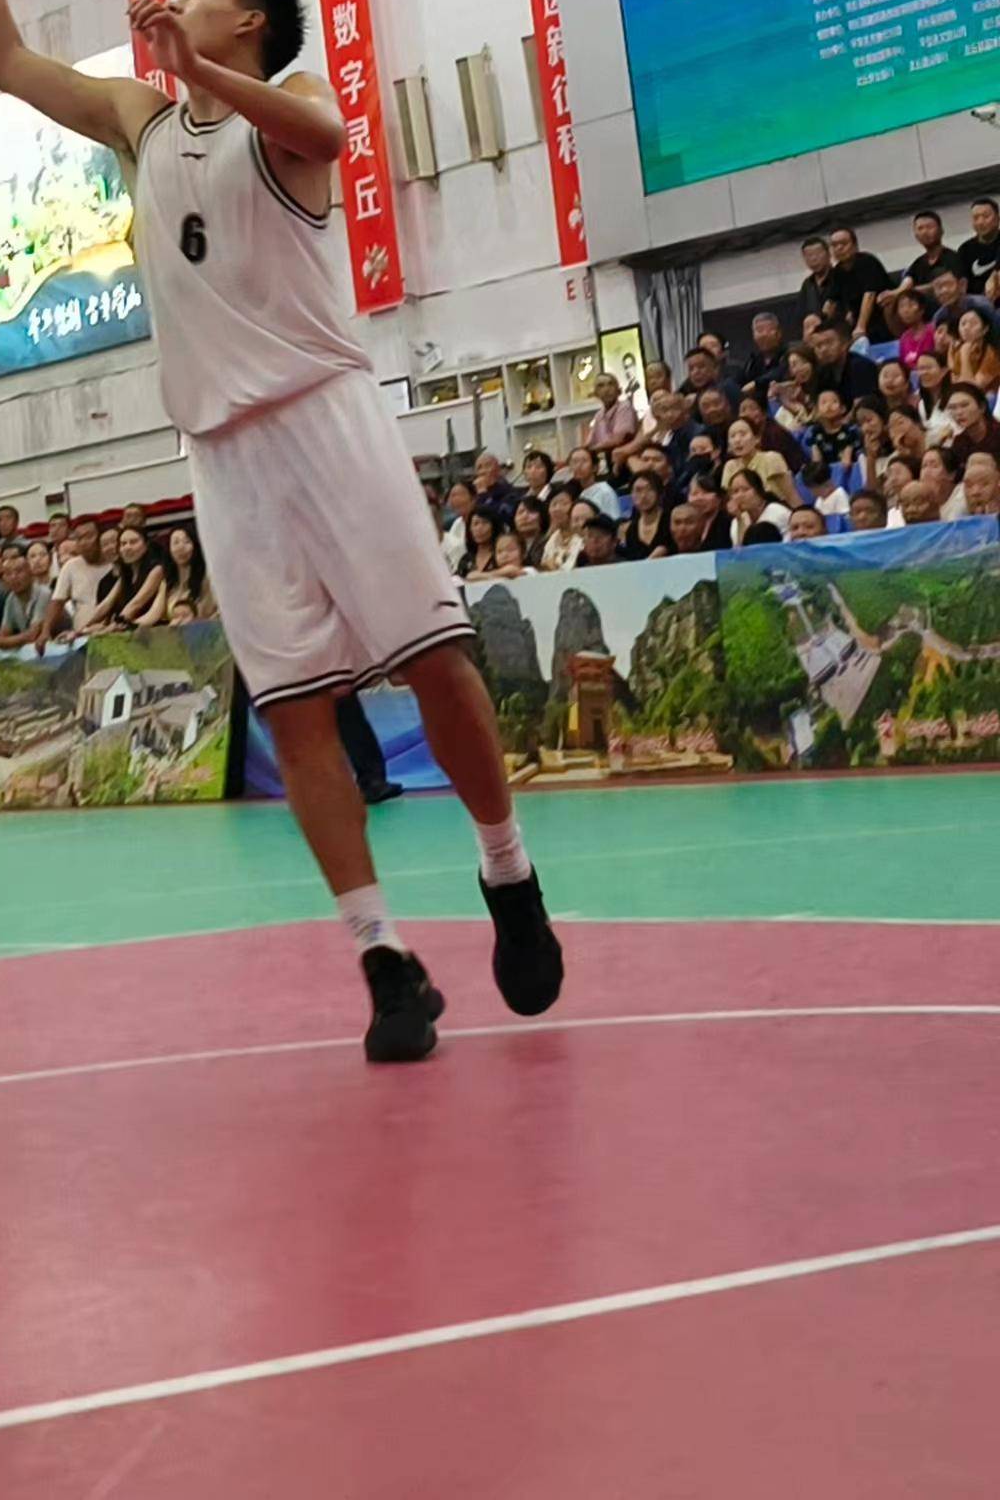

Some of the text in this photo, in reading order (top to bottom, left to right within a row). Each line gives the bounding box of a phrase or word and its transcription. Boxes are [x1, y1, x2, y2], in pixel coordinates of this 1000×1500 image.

[332, 0, 382, 221] 数字灵丘
[180, 212, 207, 265] 6
